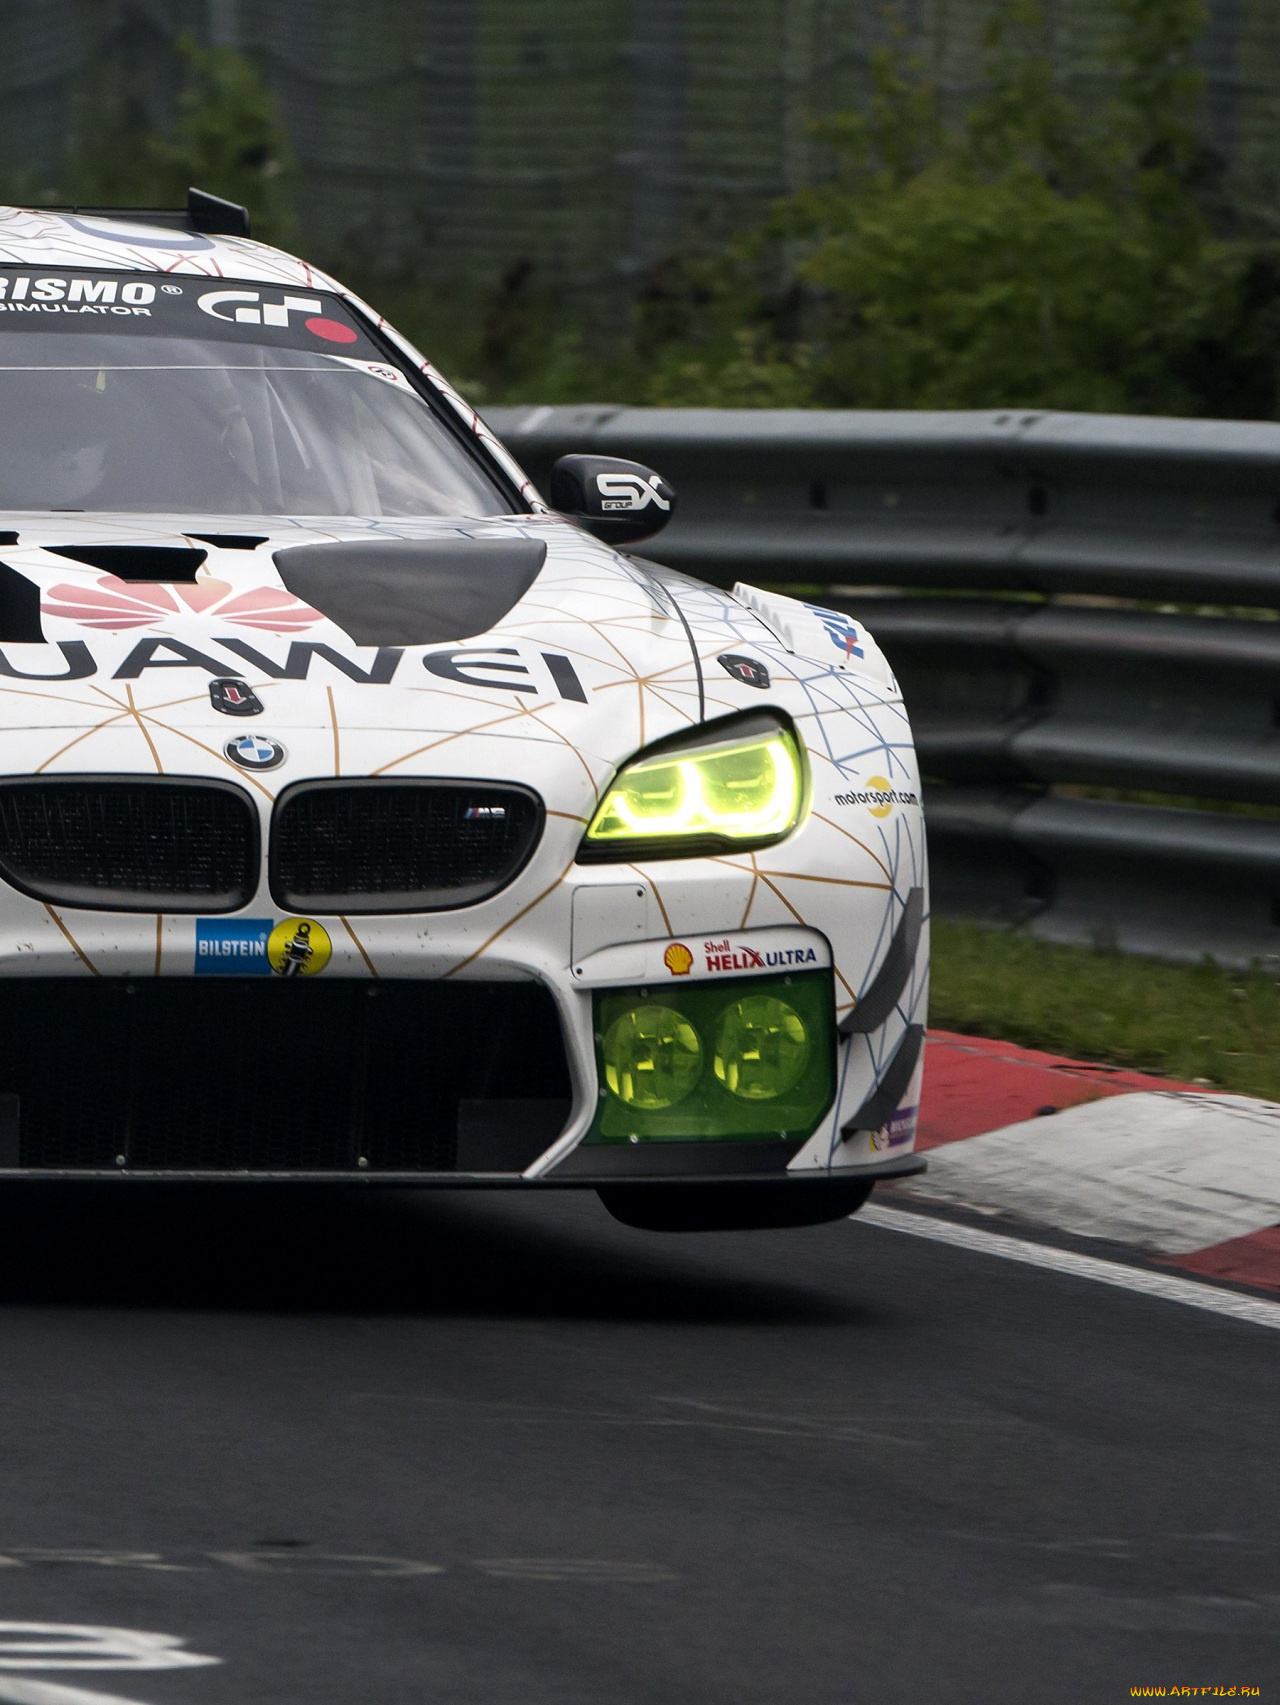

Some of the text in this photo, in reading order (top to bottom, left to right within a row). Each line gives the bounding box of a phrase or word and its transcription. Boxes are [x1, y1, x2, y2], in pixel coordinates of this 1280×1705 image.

[199, 940, 266, 956] BILSTEIN
[704, 939, 730, 954] Shell
[705, 946, 817, 972] HELIX ULTRA
